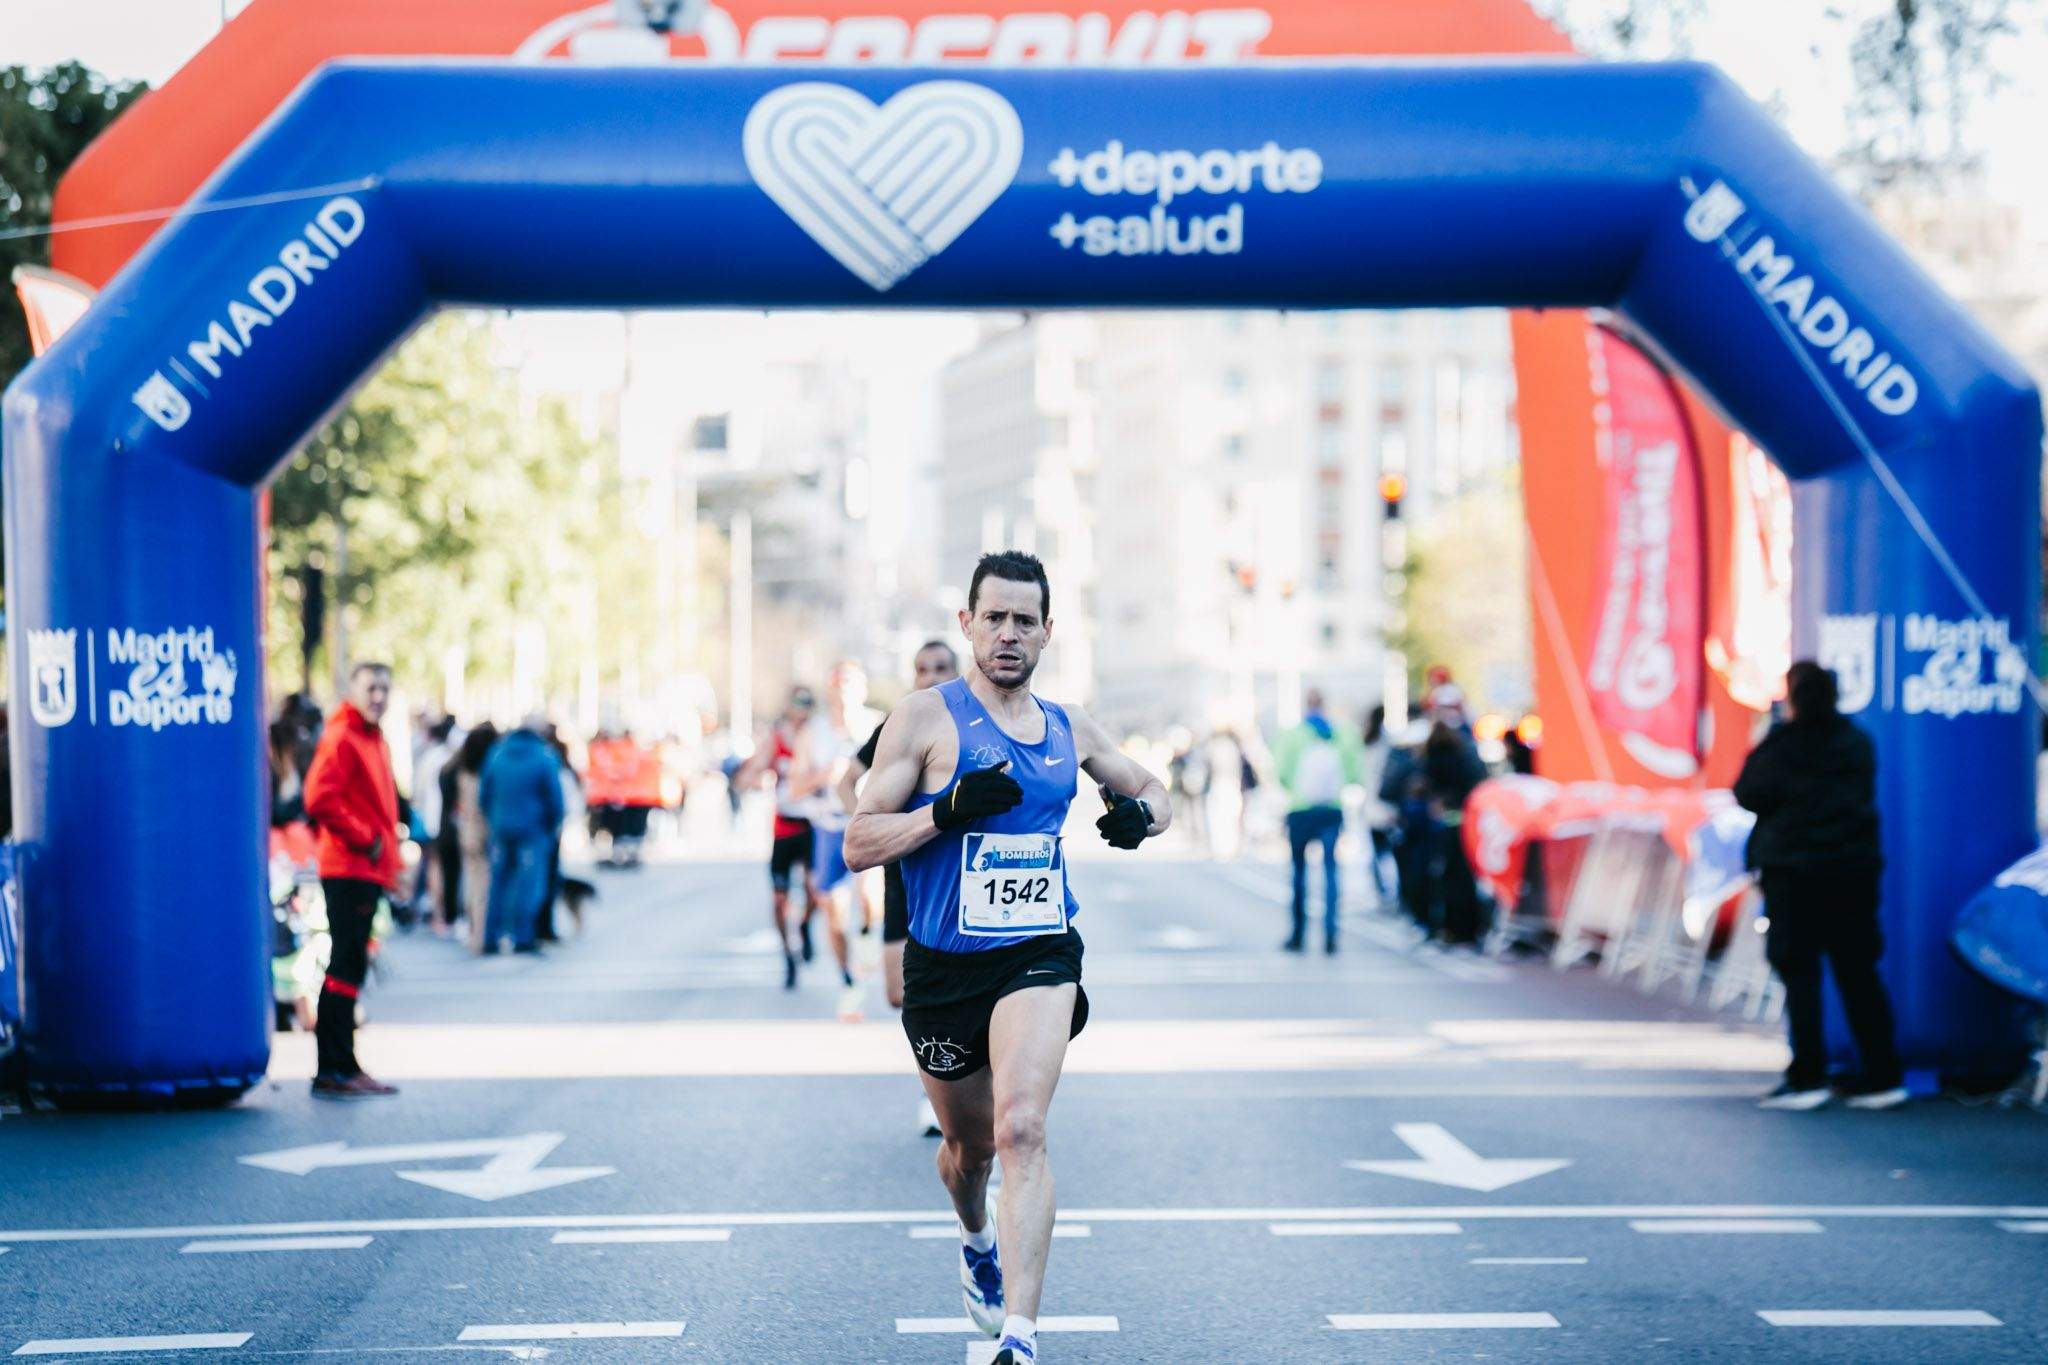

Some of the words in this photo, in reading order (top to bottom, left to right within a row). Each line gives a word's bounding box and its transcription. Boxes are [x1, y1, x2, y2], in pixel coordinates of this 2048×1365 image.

[1048, 139, 1323, 205] +deporte
[1049, 202, 1243, 256] +salud
[188, 196, 365, 378] MADRID
[1736, 235, 1918, 415] MADRID
[108, 625, 214, 664] Madrid
[108, 689, 233, 732] Deporte
[1000, 849, 1049, 860] BOMBEROS
[984, 878, 1049, 904] 1542
